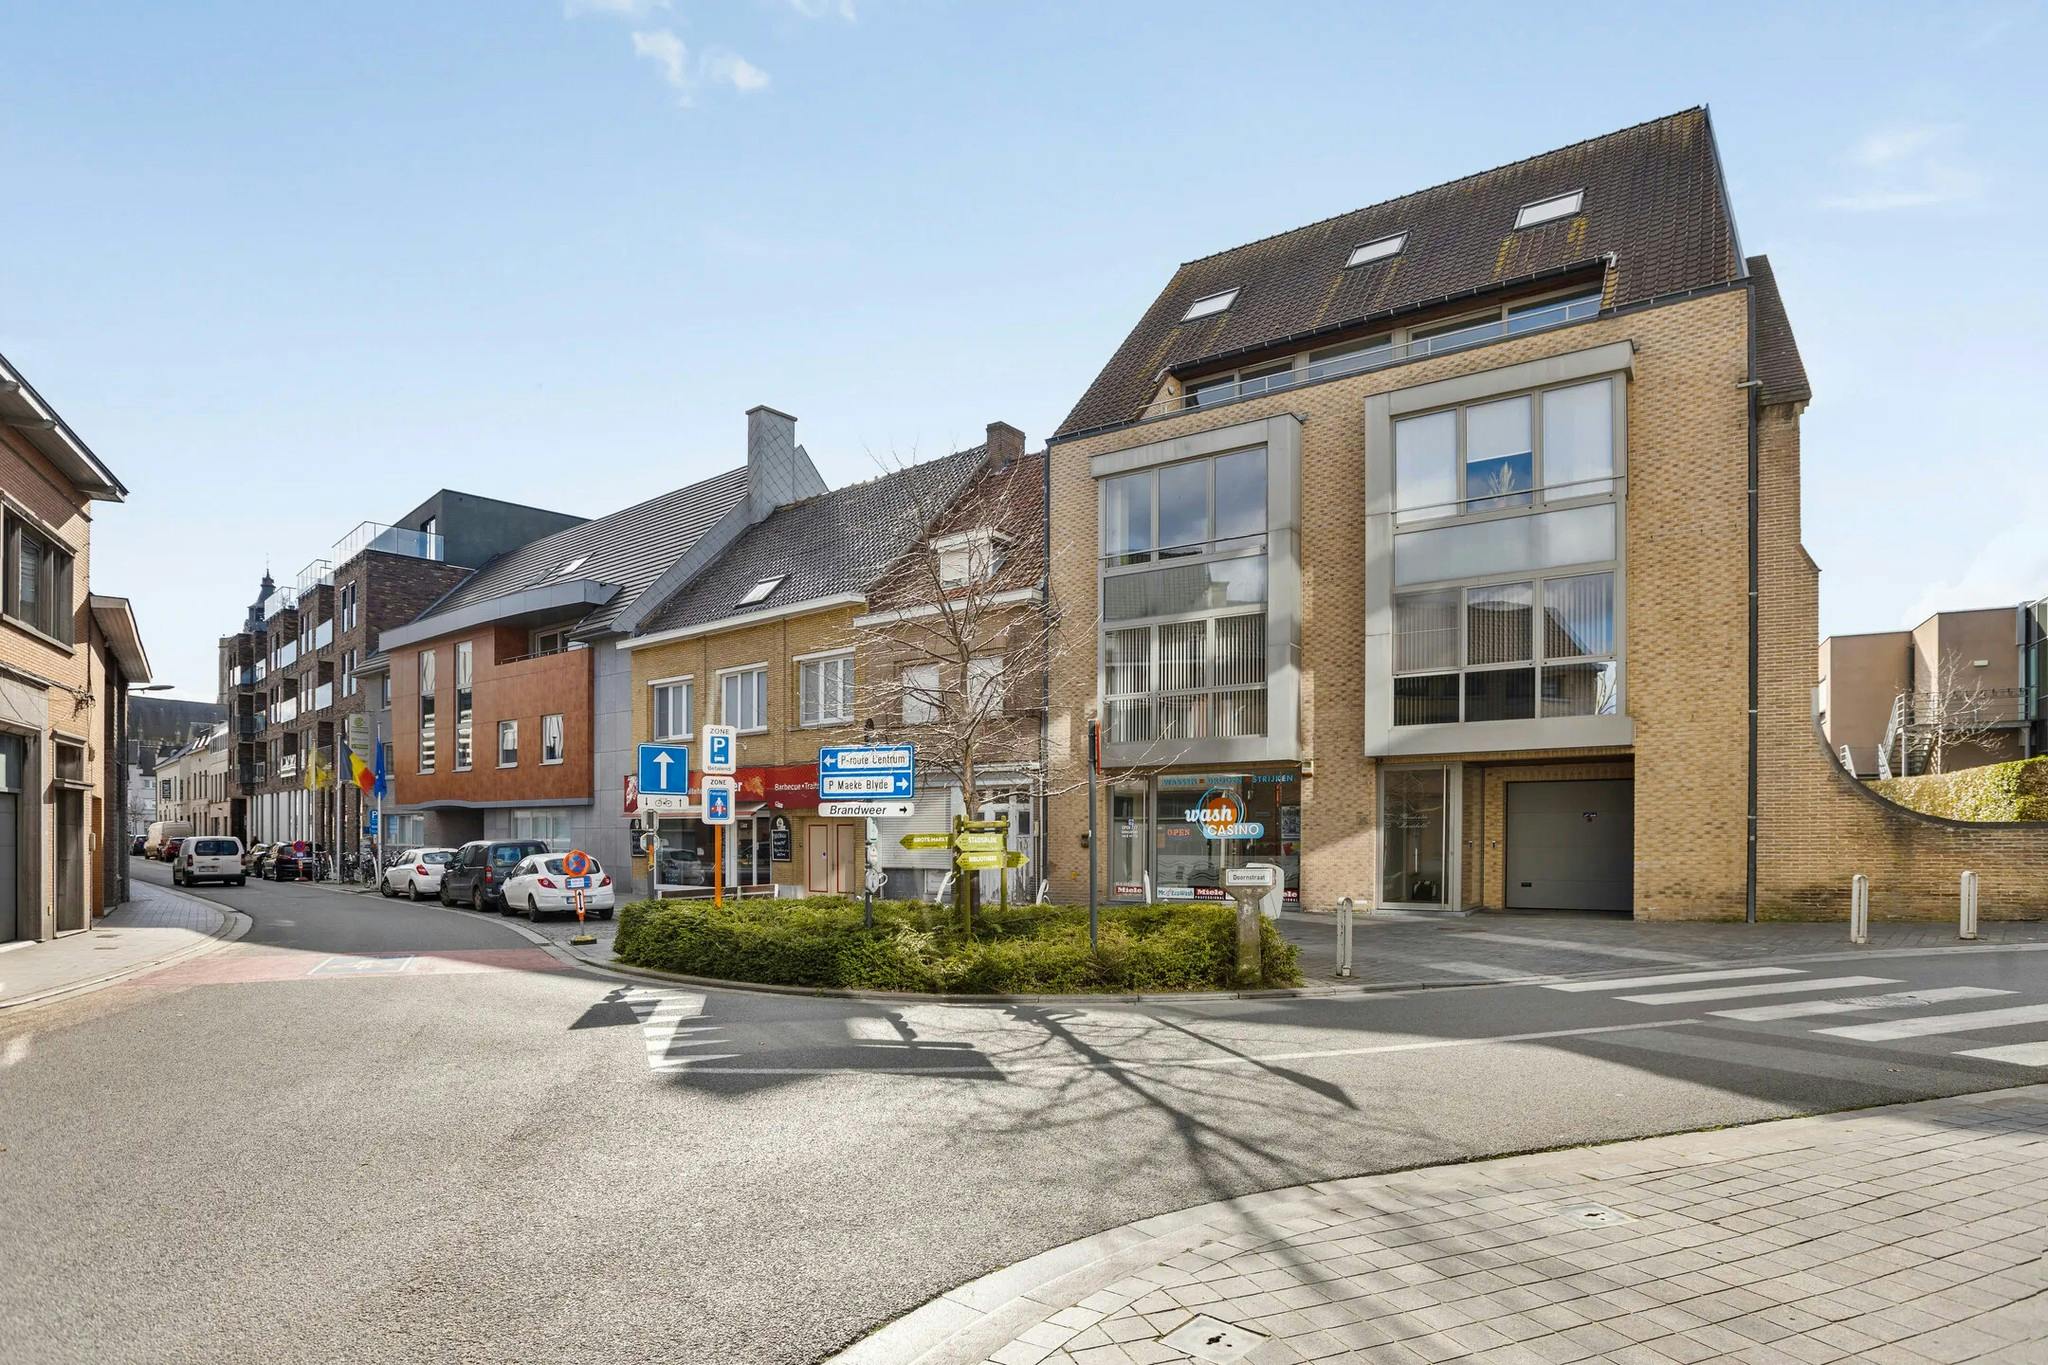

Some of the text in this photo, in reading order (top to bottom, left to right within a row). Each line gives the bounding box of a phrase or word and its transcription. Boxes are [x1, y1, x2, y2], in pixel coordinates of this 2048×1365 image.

[713, 737, 726, 753] P
[840, 754, 906, 766] P-route Centrum
[1252, 774, 1294, 783] STRIJKEN
[828, 779, 889, 792] P Maeke Blyde
[829, 804, 887, 815] Brandweer
[1184, 804, 1232, 822] wash
[1167, 828, 1191, 836] OPEN
[1207, 824, 1259, 836] CASINO
[1196, 888, 1224, 896] Miele
